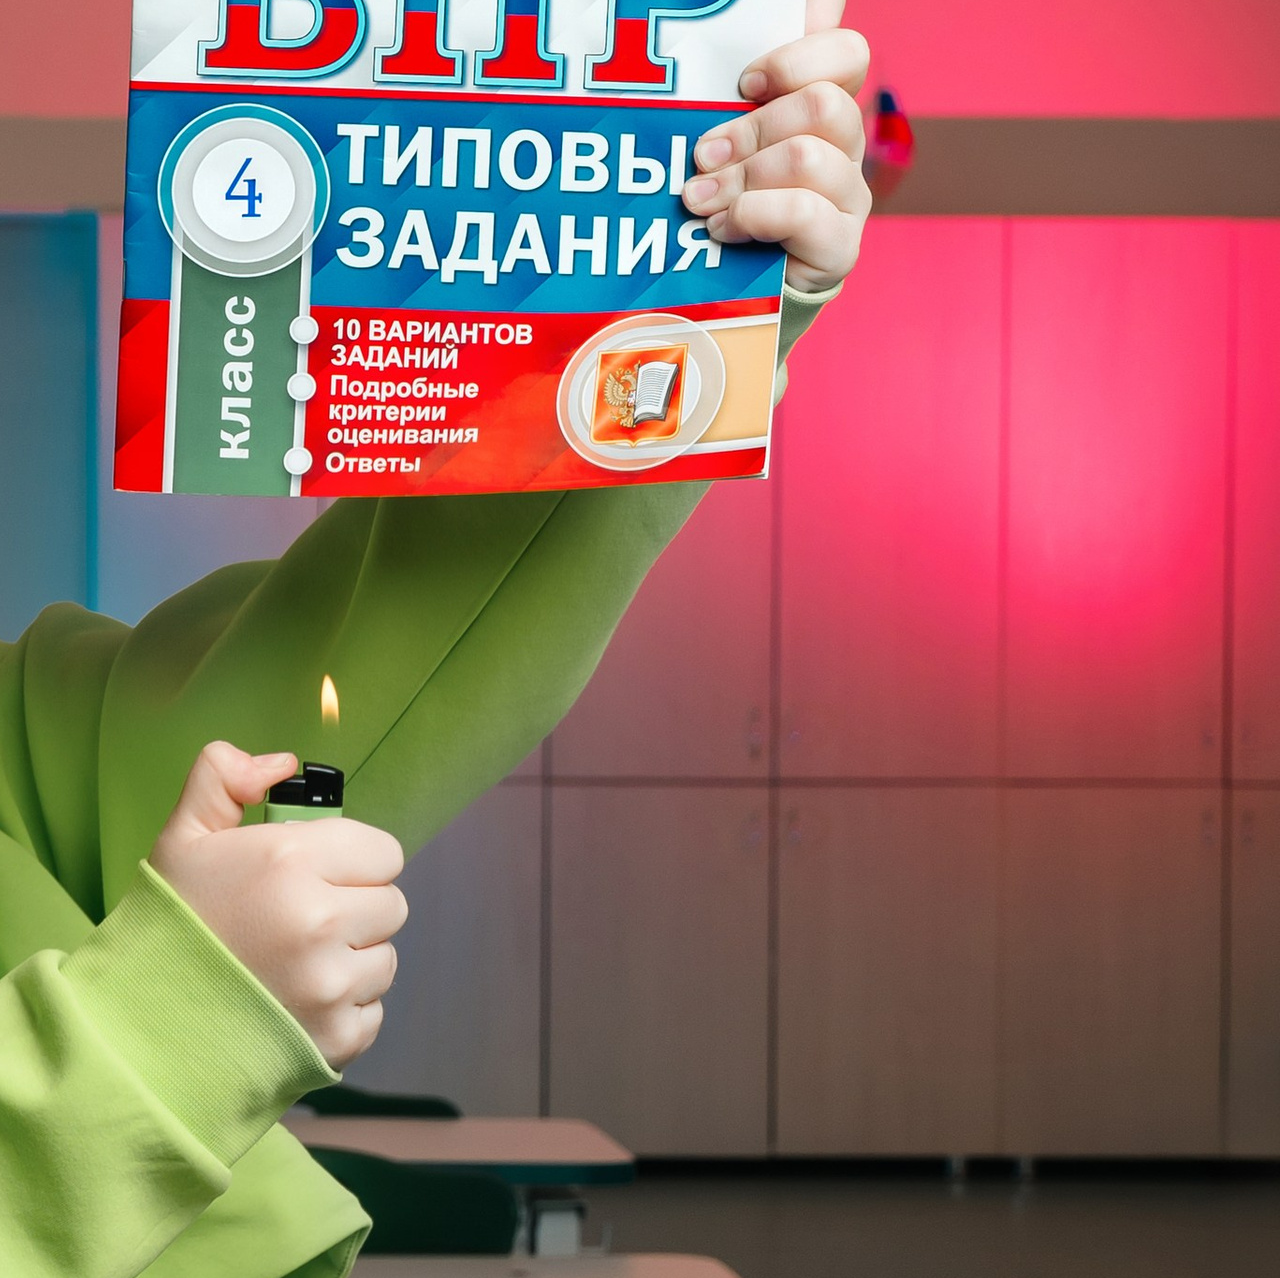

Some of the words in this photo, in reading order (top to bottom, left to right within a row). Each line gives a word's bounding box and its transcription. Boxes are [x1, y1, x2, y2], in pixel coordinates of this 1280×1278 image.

[336, 123, 688, 197] ТИПОВЫ
[224, 157, 263, 218] 4
[335, 206, 723, 285] ЗАДАНИЯ
[332, 318, 361, 341] 10
[368, 319, 533, 345] ВАРИАНТОВ
[330, 342, 459, 371] ЗАДАНИЙ
[218, 295, 256, 460] класс
[329, 374, 480, 402] Подробные
[328, 403, 447, 426] критерии
[326, 426, 479, 447] оценивания
[324, 451, 421, 473] Ответы
